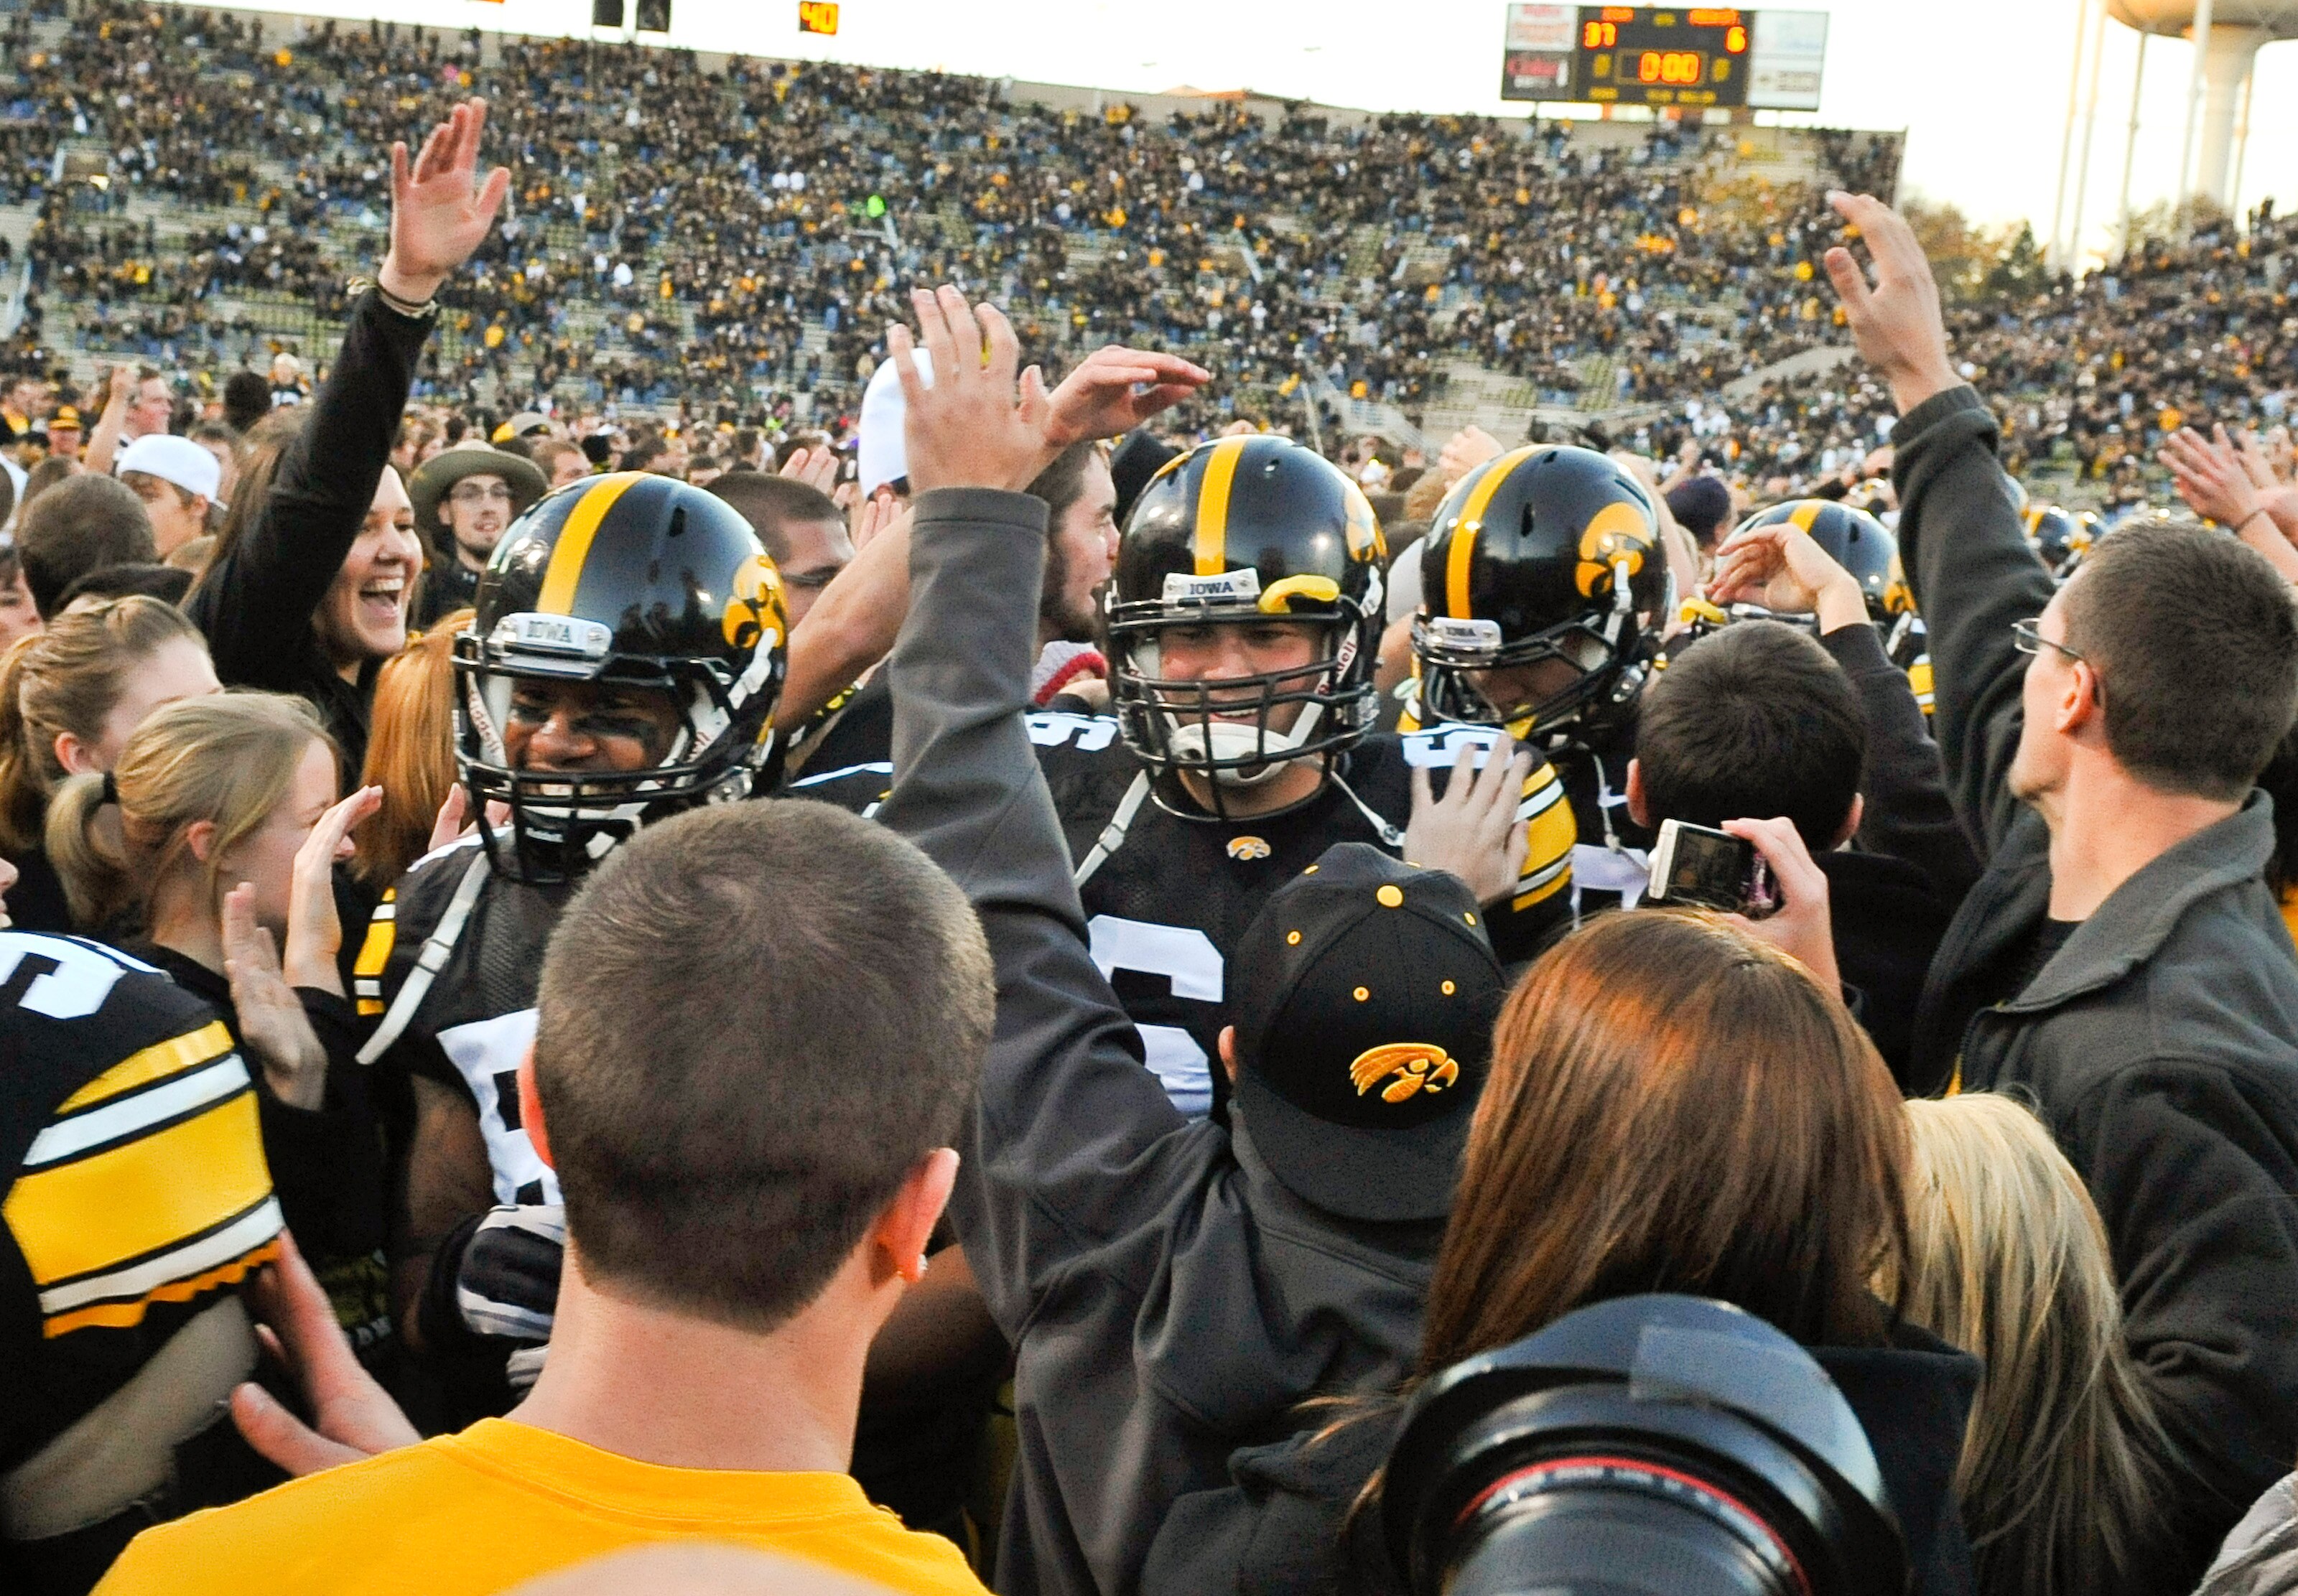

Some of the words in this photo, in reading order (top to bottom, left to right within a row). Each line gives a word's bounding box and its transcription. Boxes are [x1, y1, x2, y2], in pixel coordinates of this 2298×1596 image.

[800, 2, 839, 34] 40
[1583, 21, 1616, 49] 37
[1725, 25, 1747, 53] 6
[1639, 51, 1700, 84] 0:00
[1189, 581, 1234, 594] IOWA
